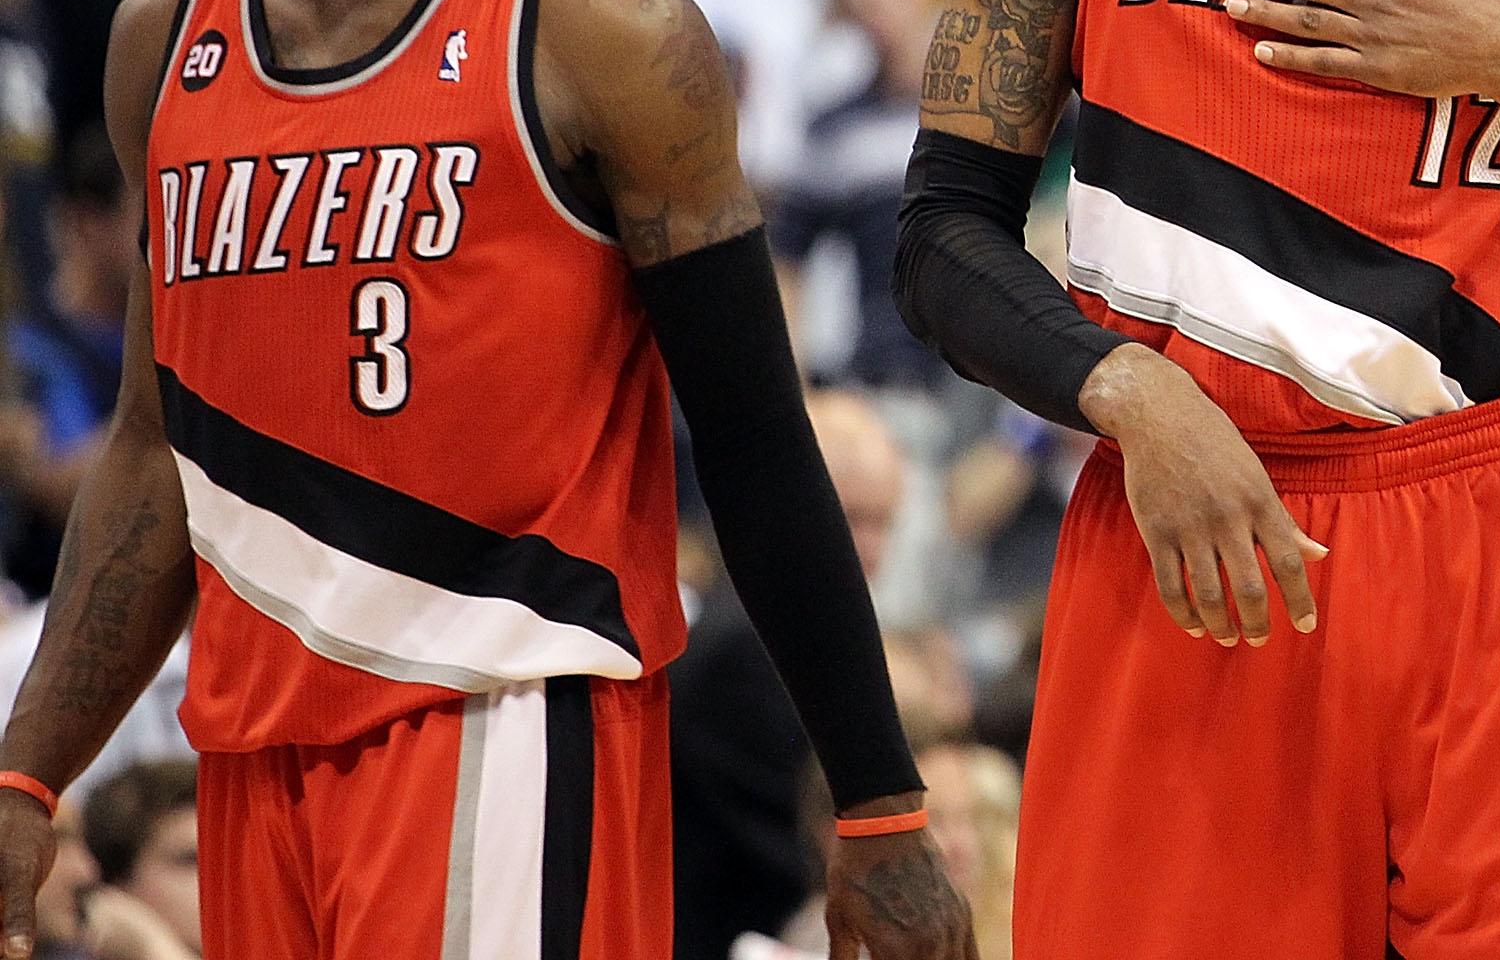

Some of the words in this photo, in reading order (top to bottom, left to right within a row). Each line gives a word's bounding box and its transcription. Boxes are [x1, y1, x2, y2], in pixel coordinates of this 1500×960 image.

[182, 42, 222, 80] 20
[158, 141, 480, 288] BLAZERS
[349, 276, 413, 417] 3
